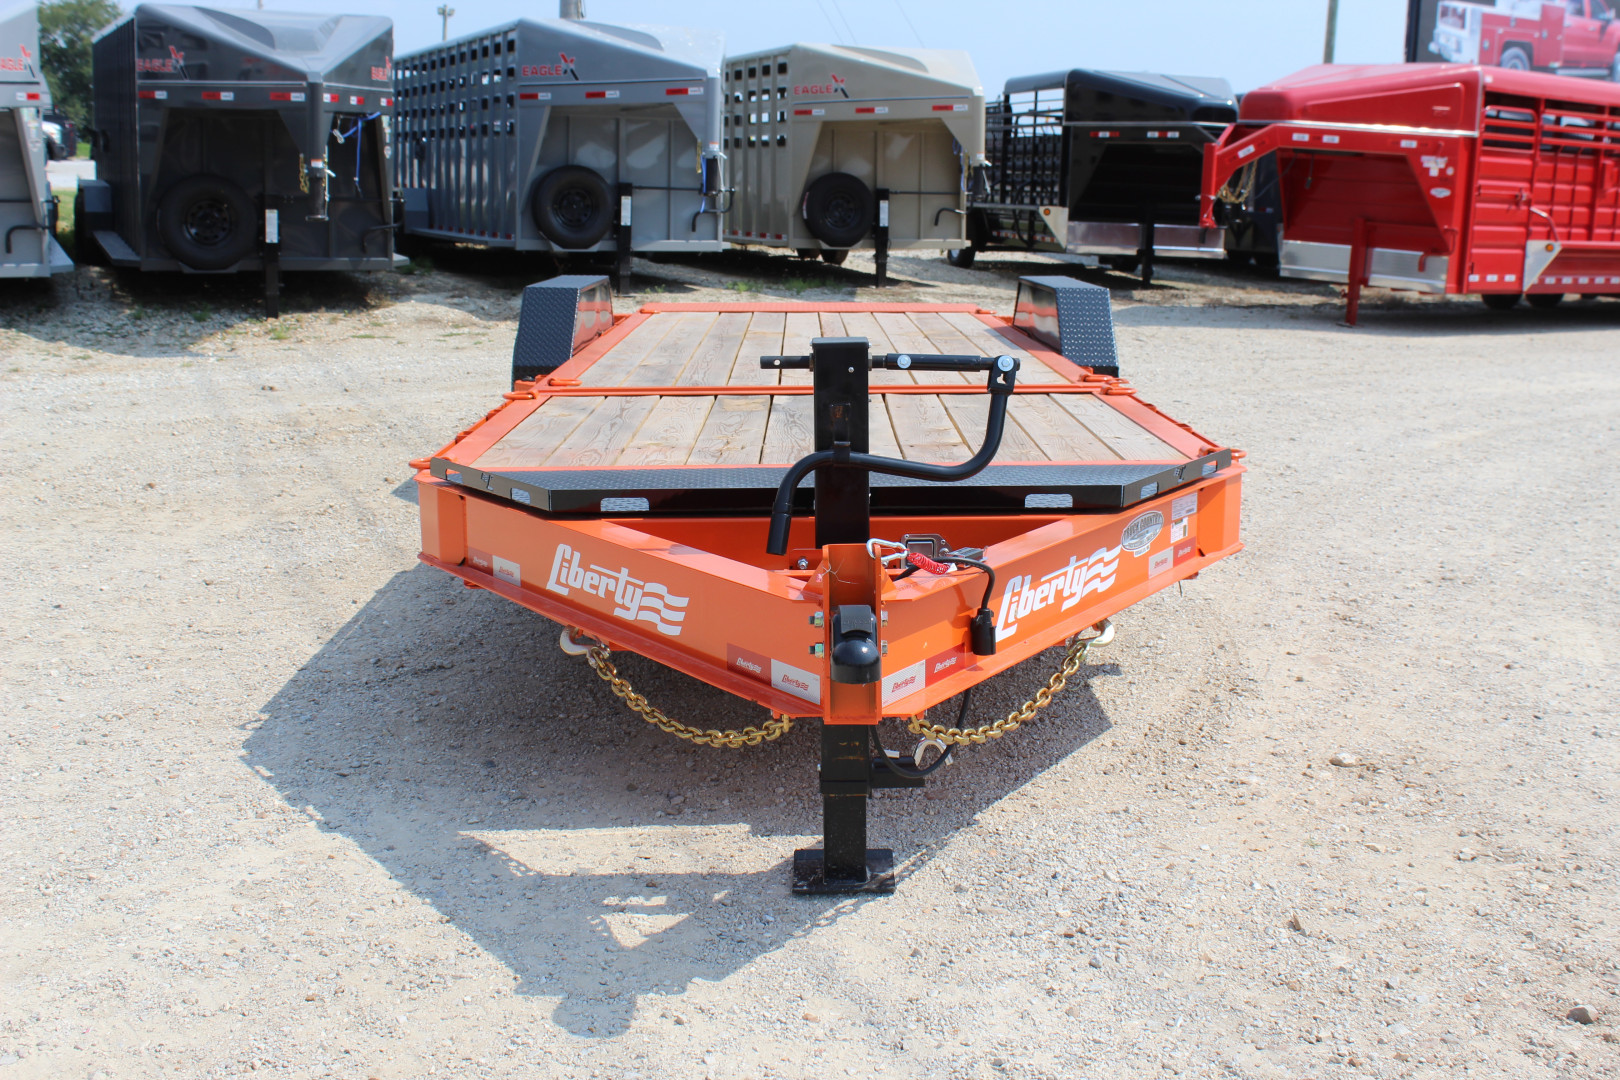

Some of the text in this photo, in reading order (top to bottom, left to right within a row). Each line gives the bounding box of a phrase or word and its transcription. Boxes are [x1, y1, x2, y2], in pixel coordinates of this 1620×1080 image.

[137, 59, 173, 72] EAGLE
[522, 65, 562, 77] EAGLE
[793, 84, 833, 95] EAGLE
[546, 543, 645, 621] Liberty
[995, 555, 1089, 642] Liberty
